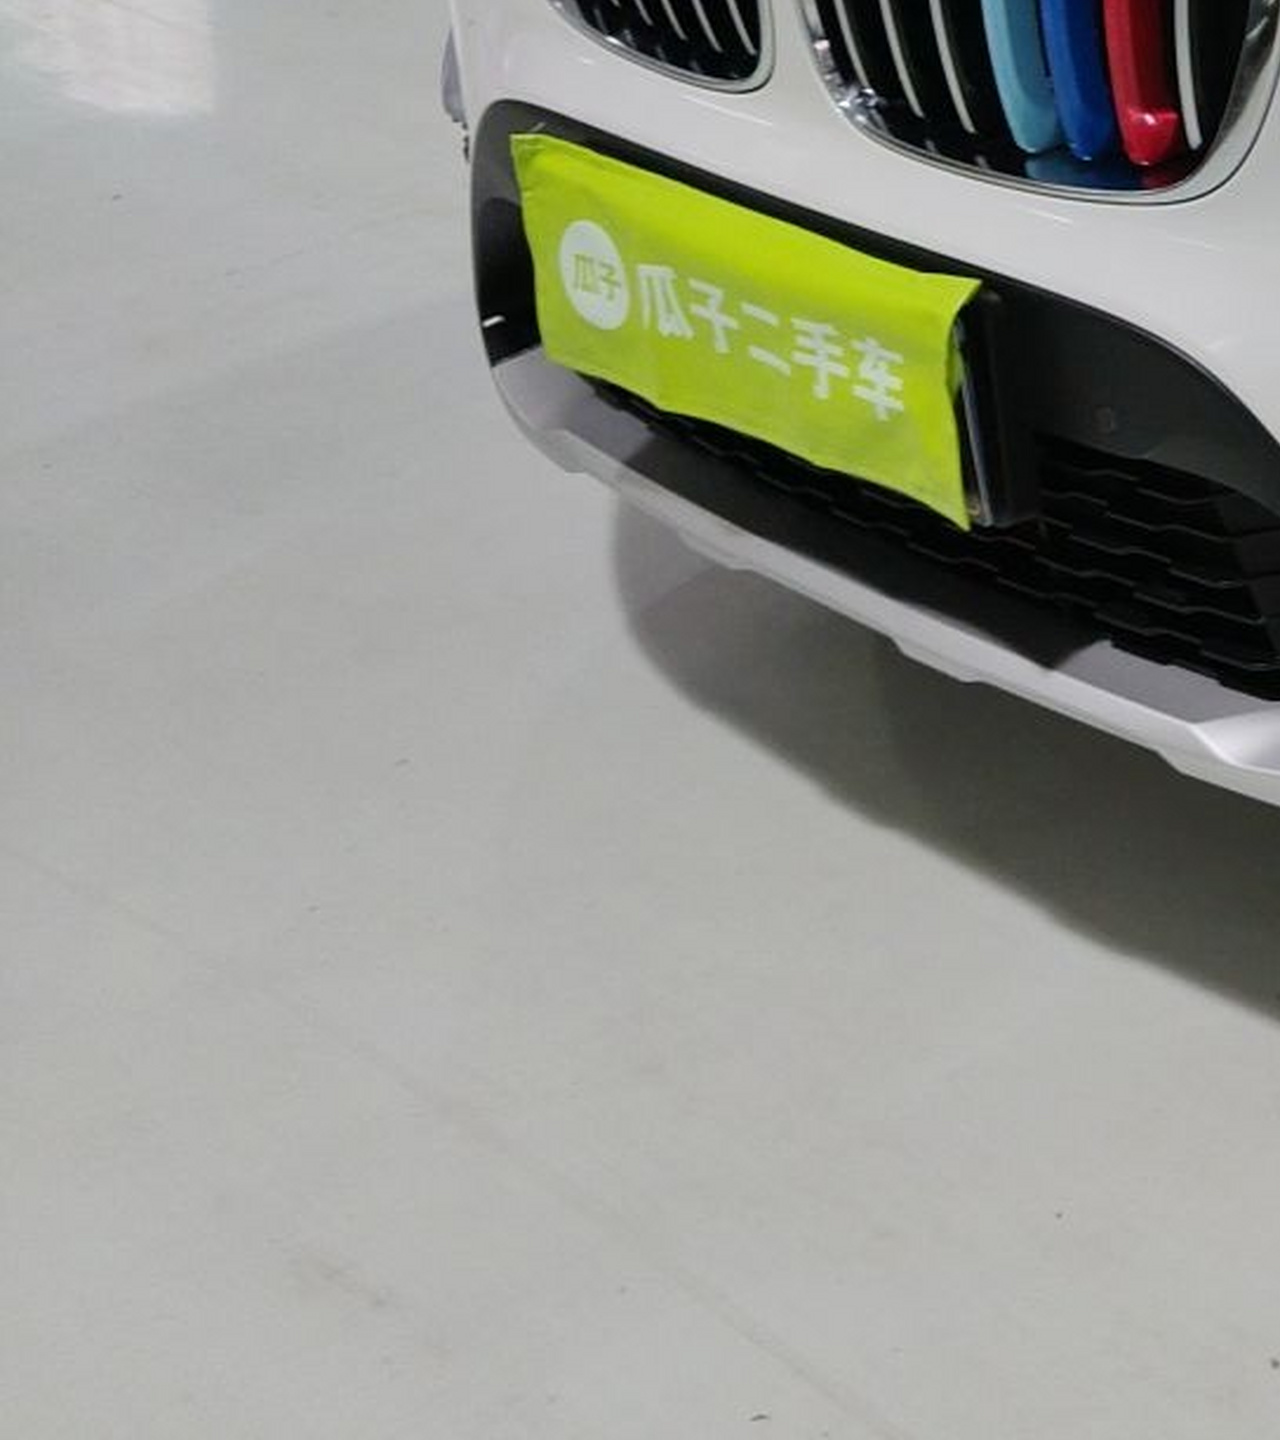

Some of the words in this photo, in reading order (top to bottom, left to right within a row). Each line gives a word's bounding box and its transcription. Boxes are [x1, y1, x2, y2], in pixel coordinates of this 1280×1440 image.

[573, 253, 622, 302] 瓜子
[637, 262, 905, 422] 瓜子二手车
